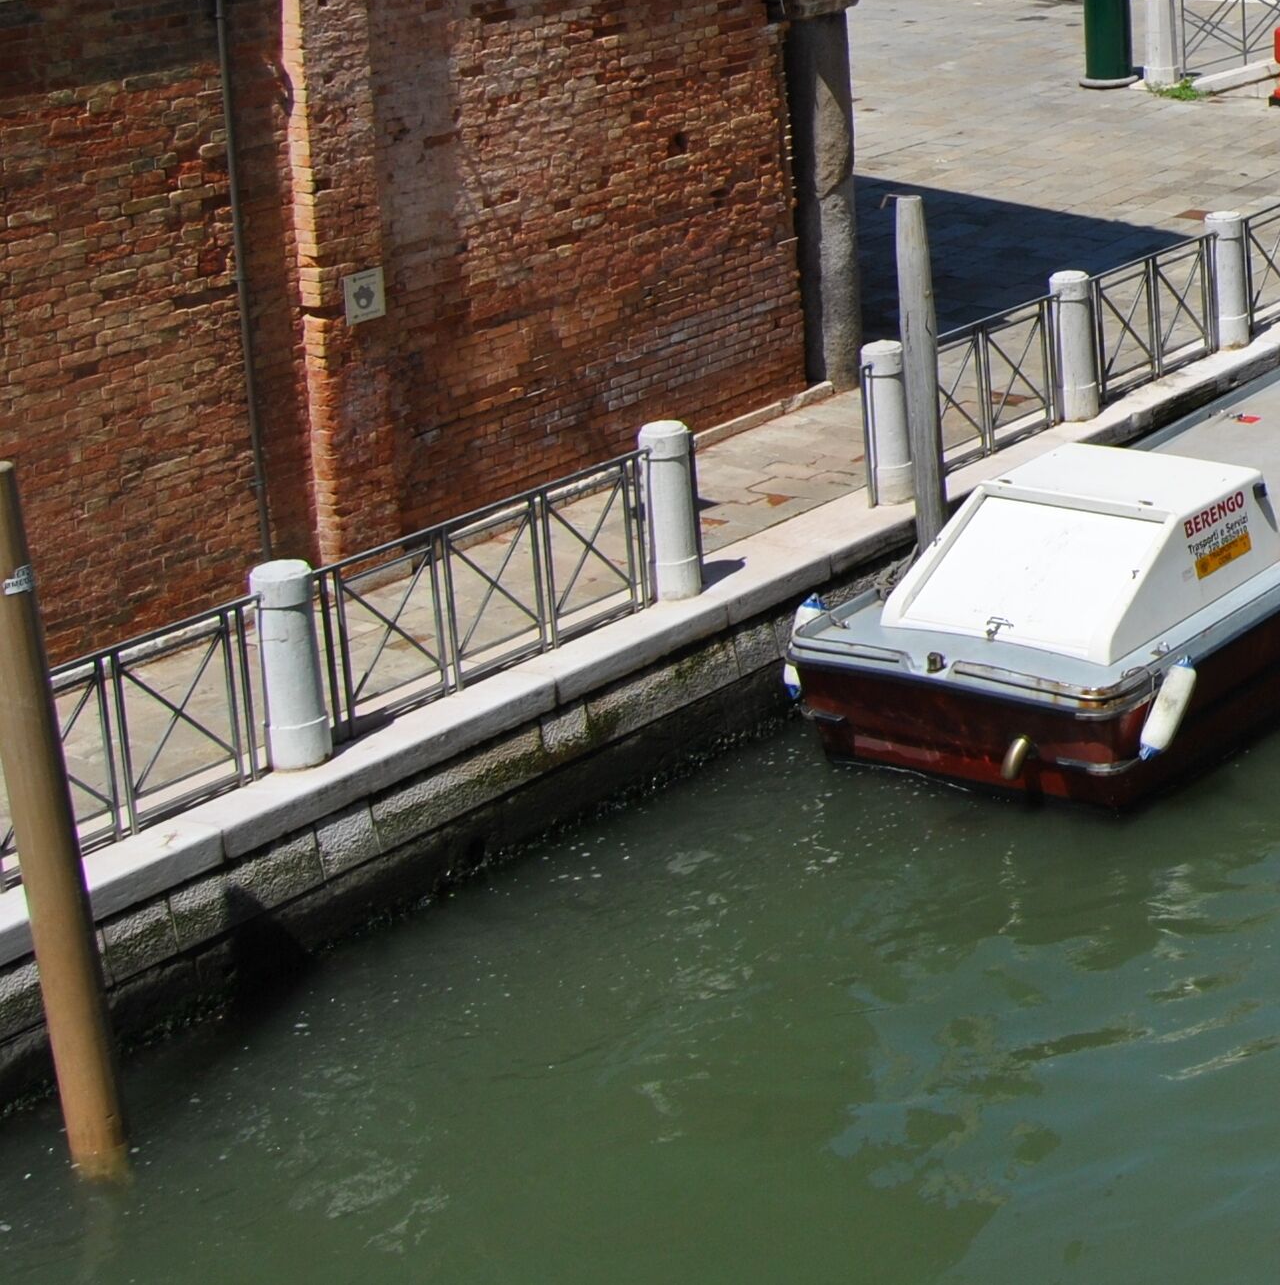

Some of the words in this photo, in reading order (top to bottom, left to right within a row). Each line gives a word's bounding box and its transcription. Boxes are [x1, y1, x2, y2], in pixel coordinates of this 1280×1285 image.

[1184, 491, 1244, 538] BERENGO
[1188, 528, 1219, 555] Trasporti
[1225, 512, 1248, 533] Servizi
